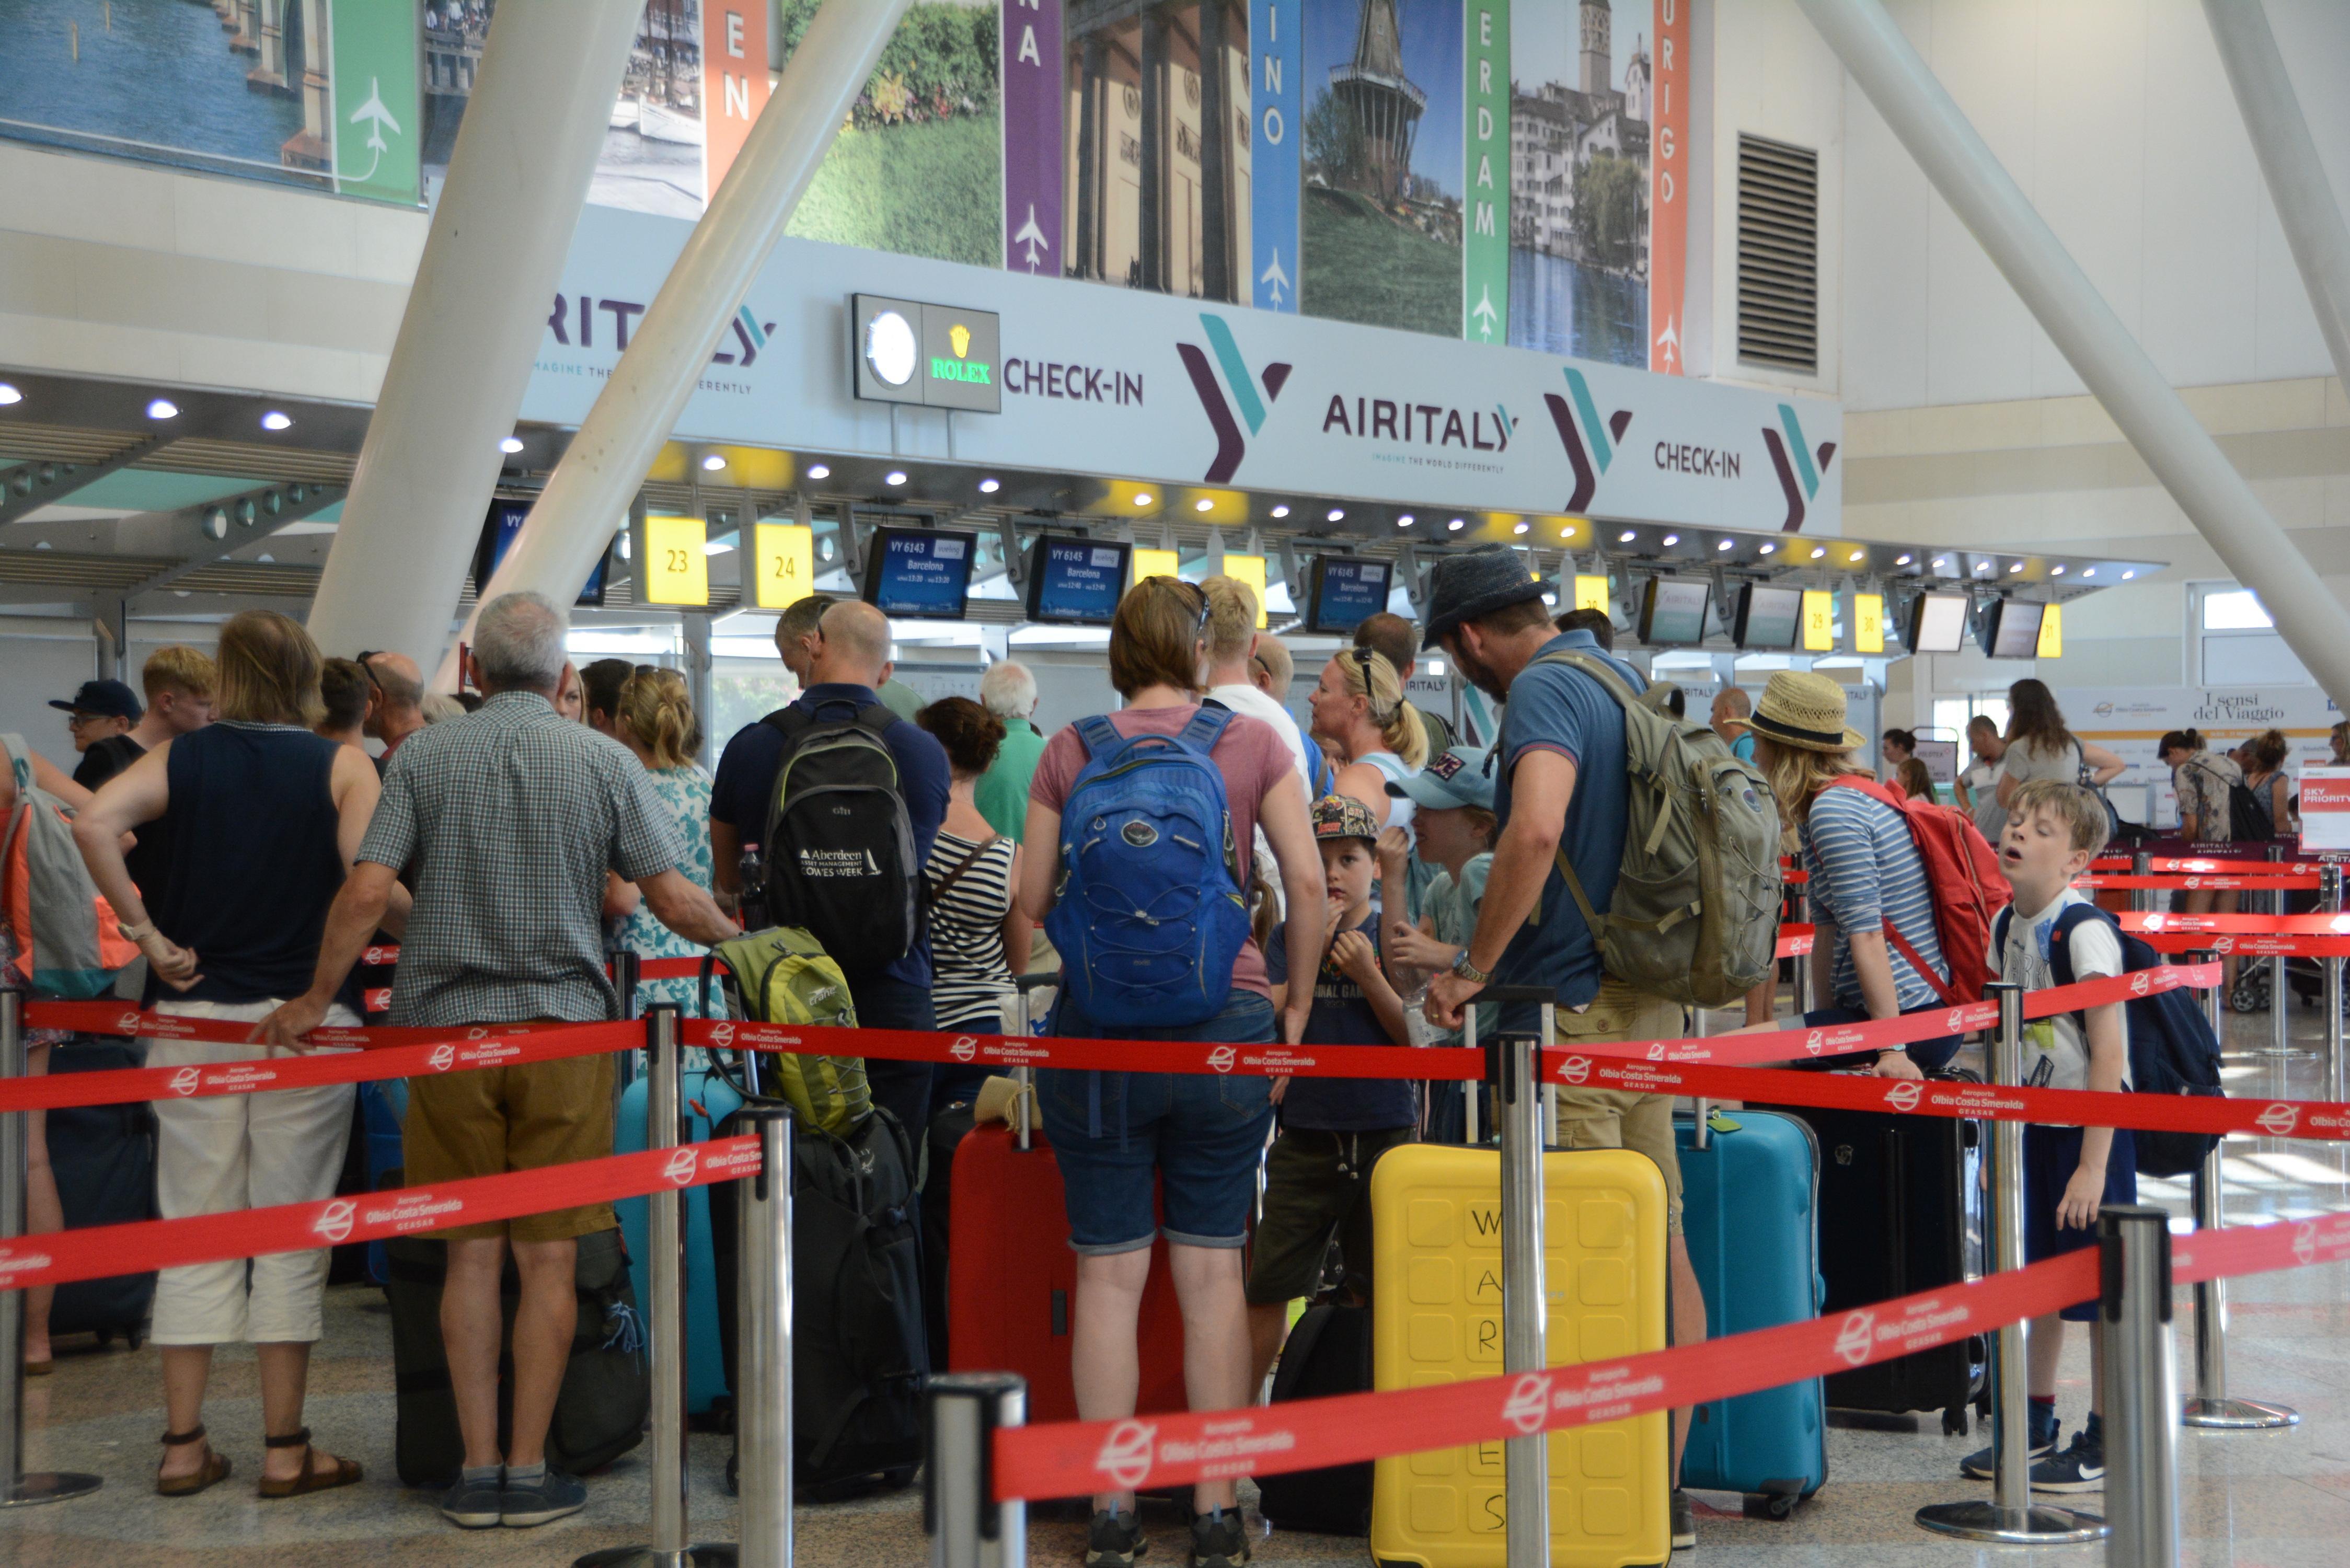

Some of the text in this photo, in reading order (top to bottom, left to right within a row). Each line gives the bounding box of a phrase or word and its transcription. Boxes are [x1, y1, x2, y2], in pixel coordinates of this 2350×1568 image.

[1019, 0, 1041, 67] A
[1475, 9, 1495, 237] ERDAM
[931, 358, 990, 384] ROLEX
[1004, 358, 1143, 407] CHECK-IN
[1323, 395, 1518, 453] AIRITALY
[1372, 453, 1504, 474] IMAGINE THE WORLD DIFFERENTLY
[1655, 441, 1740, 479] CHECK-IN
[891, 541, 925, 554] VY 6143
[667, 549, 688, 573] 23
[1052, 550, 1082, 561] VY 6145
[775, 557, 796, 579] 24
[907, 560, 944, 571] Barcelona
[1328, 567, 1337, 577] VY
[1067, 568, 1100, 579] Barcelona
[1813, 614, 1823, 629] 29
[2045, 625, 2053, 638] 31
[2217, 694, 2259, 706] sensi
[2194, 707, 2284, 723] del Viaggio
[811, 850, 862, 860] Aberdeen
[801, 867, 863, 877] COWES WEEK
[809, 986, 837, 1006] crane
[742, 1033, 756, 1041] Olbia
[774, 1035, 801, 1045] Smeralda
[461, 1047, 521, 1061] Olbia Costa Smeralda
[984, 1046, 1050, 1057] Olbia Costa Smeralda
[1243, 1056, 1315, 1066] Olbia Costa Smeralda
[1626, 1063, 1656, 1072] Aeroporto
[206, 1071, 277, 1085] Olbia Costa Smeralda
[1599, 1068, 1681, 1084] Olbia Costa Smeralda
[1623, 1081, 1655, 1090] GEASAR
[1931, 1095, 2024, 1110] Olbia Costa Smeralda
[1959, 1108, 1995, 1116] GEASAR
[2310, 1116, 2336, 1126] Olbia
[732, 1142, 761, 1151] Aeroporto
[706, 1156, 727, 1169] Olbia
[728, 1153, 749, 1165] Costa
[398, 1194, 432, 1205] Aeroporto
[366, 1200, 463, 1224] Olbia Costa Smeralda
[397, 1218, 434, 1231] GEASAR
